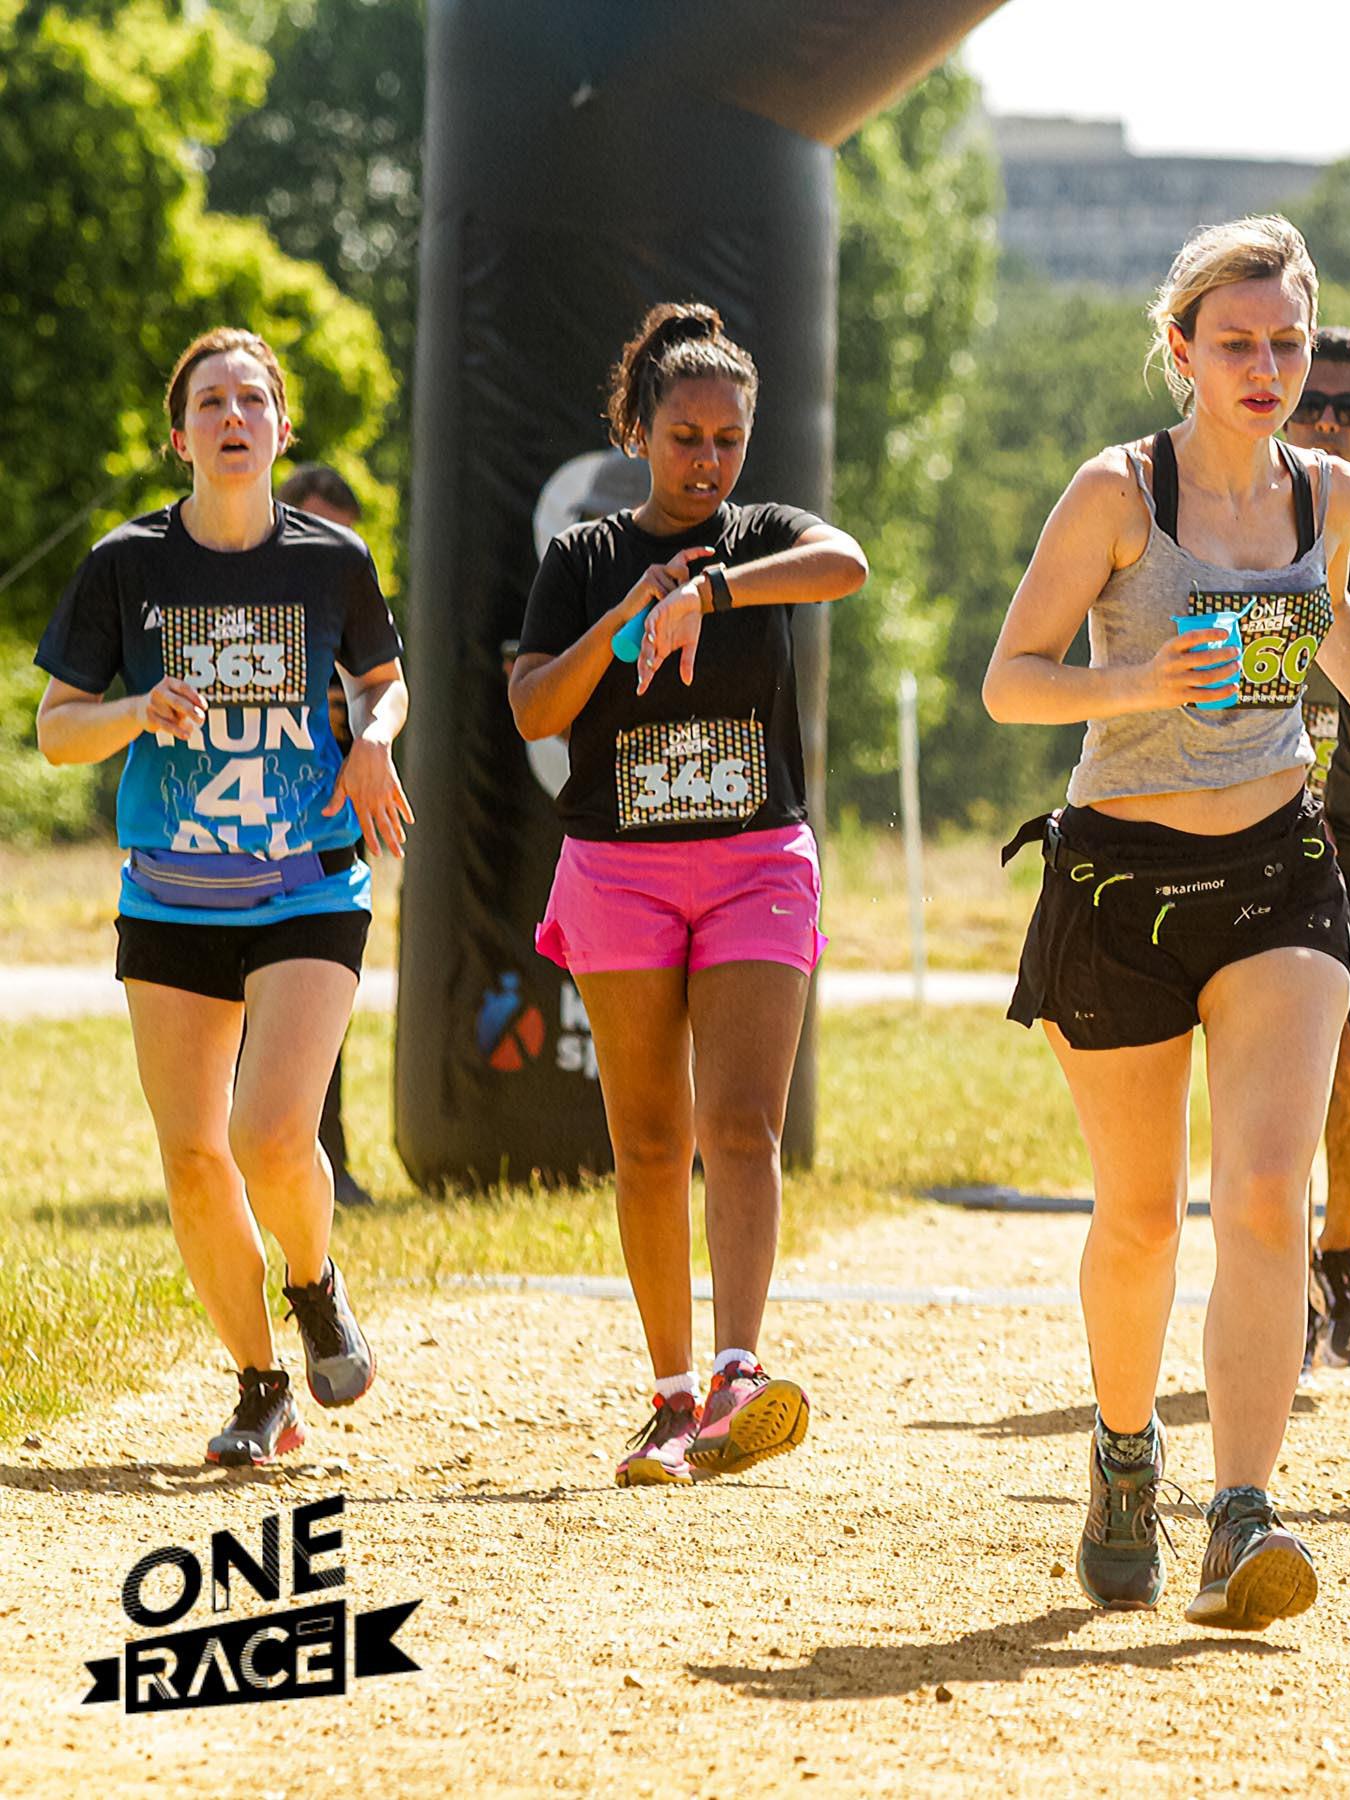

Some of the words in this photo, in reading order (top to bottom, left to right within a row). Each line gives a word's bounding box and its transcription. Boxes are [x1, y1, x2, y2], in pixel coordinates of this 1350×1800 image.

[1250, 597, 1288, 621] ONE
[182, 642, 286, 689] 363
[669, 723, 702, 746] ONE
[194, 756, 278, 825] 4
[635, 758, 749, 808] 346
[1171, 879, 1226, 896] karrimor
